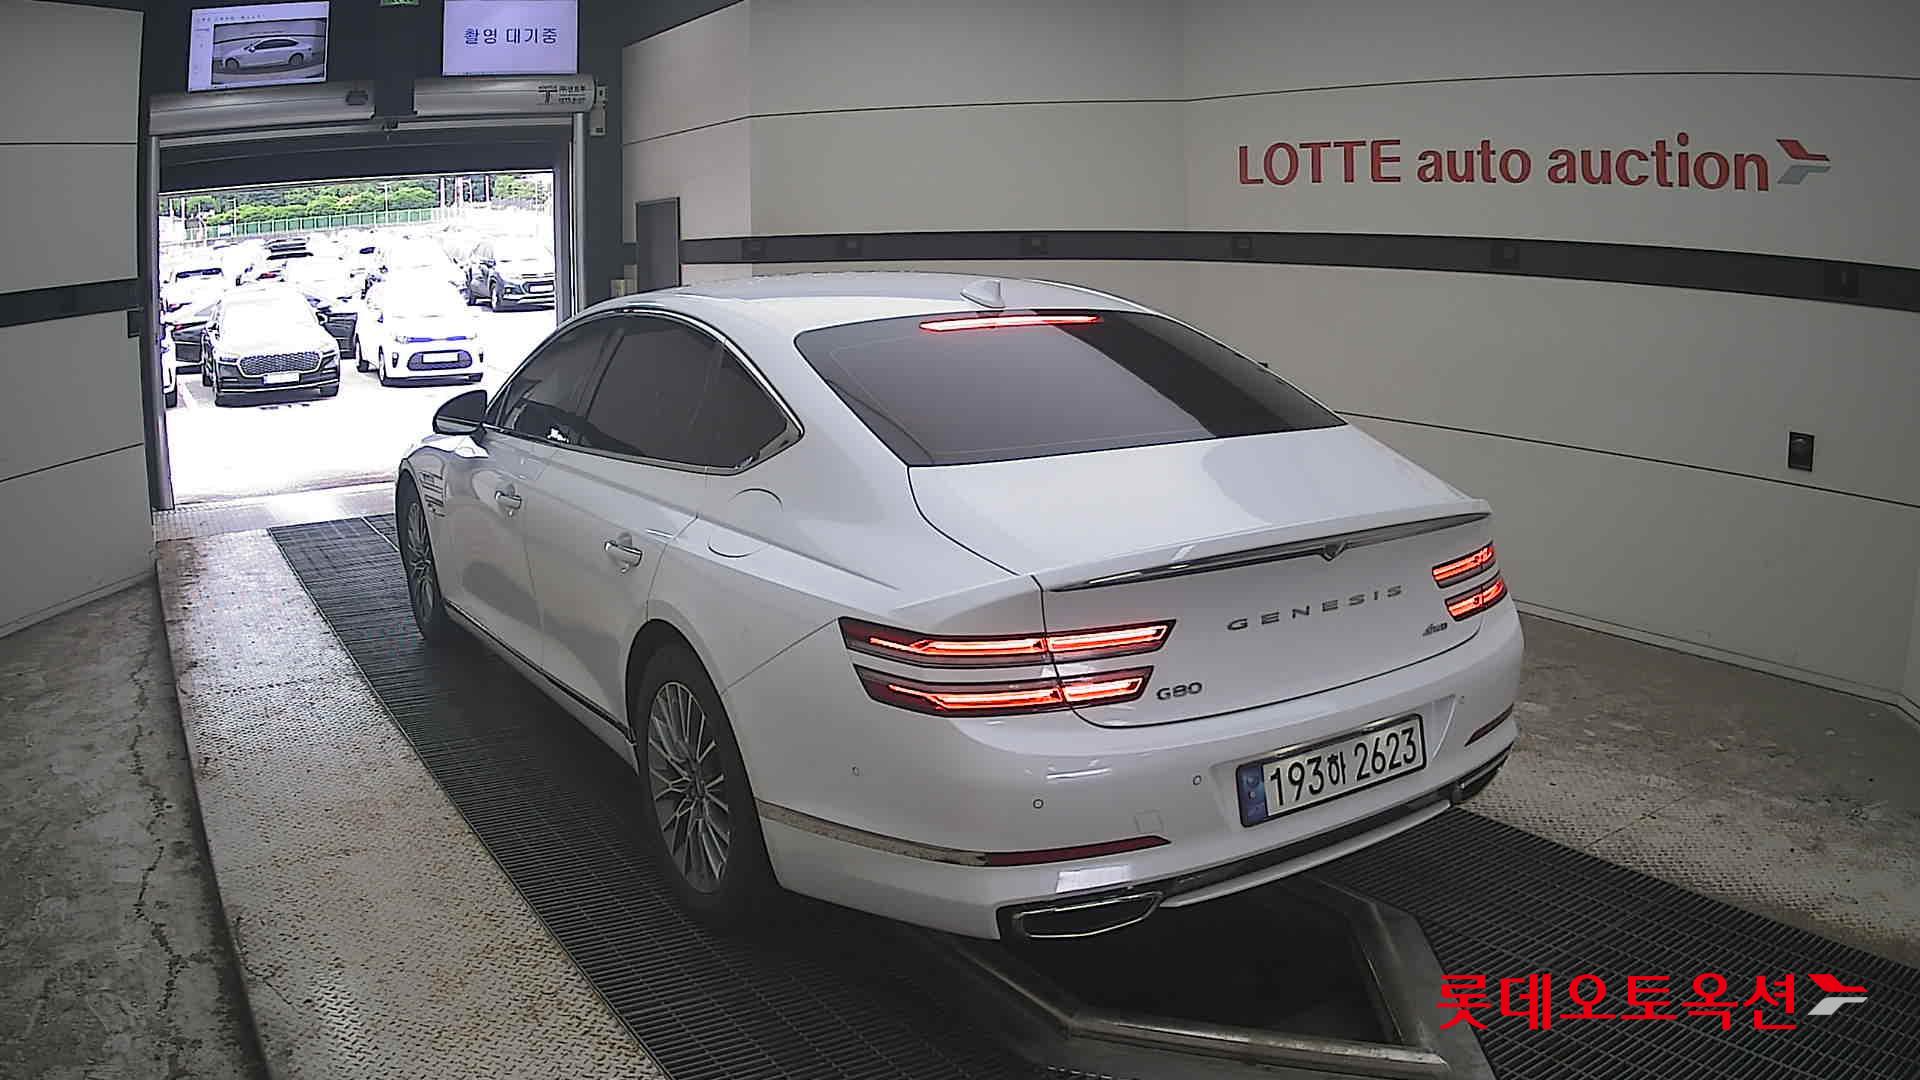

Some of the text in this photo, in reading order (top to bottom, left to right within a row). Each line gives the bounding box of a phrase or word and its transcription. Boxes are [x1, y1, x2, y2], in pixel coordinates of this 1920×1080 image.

[464, 28, 558, 45] 촬영 대기중
[1238, 132, 1769, 192] LOTTE auto auction
[1227, 585, 1403, 631] GENESIS
[1156, 681, 1203, 700] G80
[1270, 727, 1417, 806] 193하 2623
